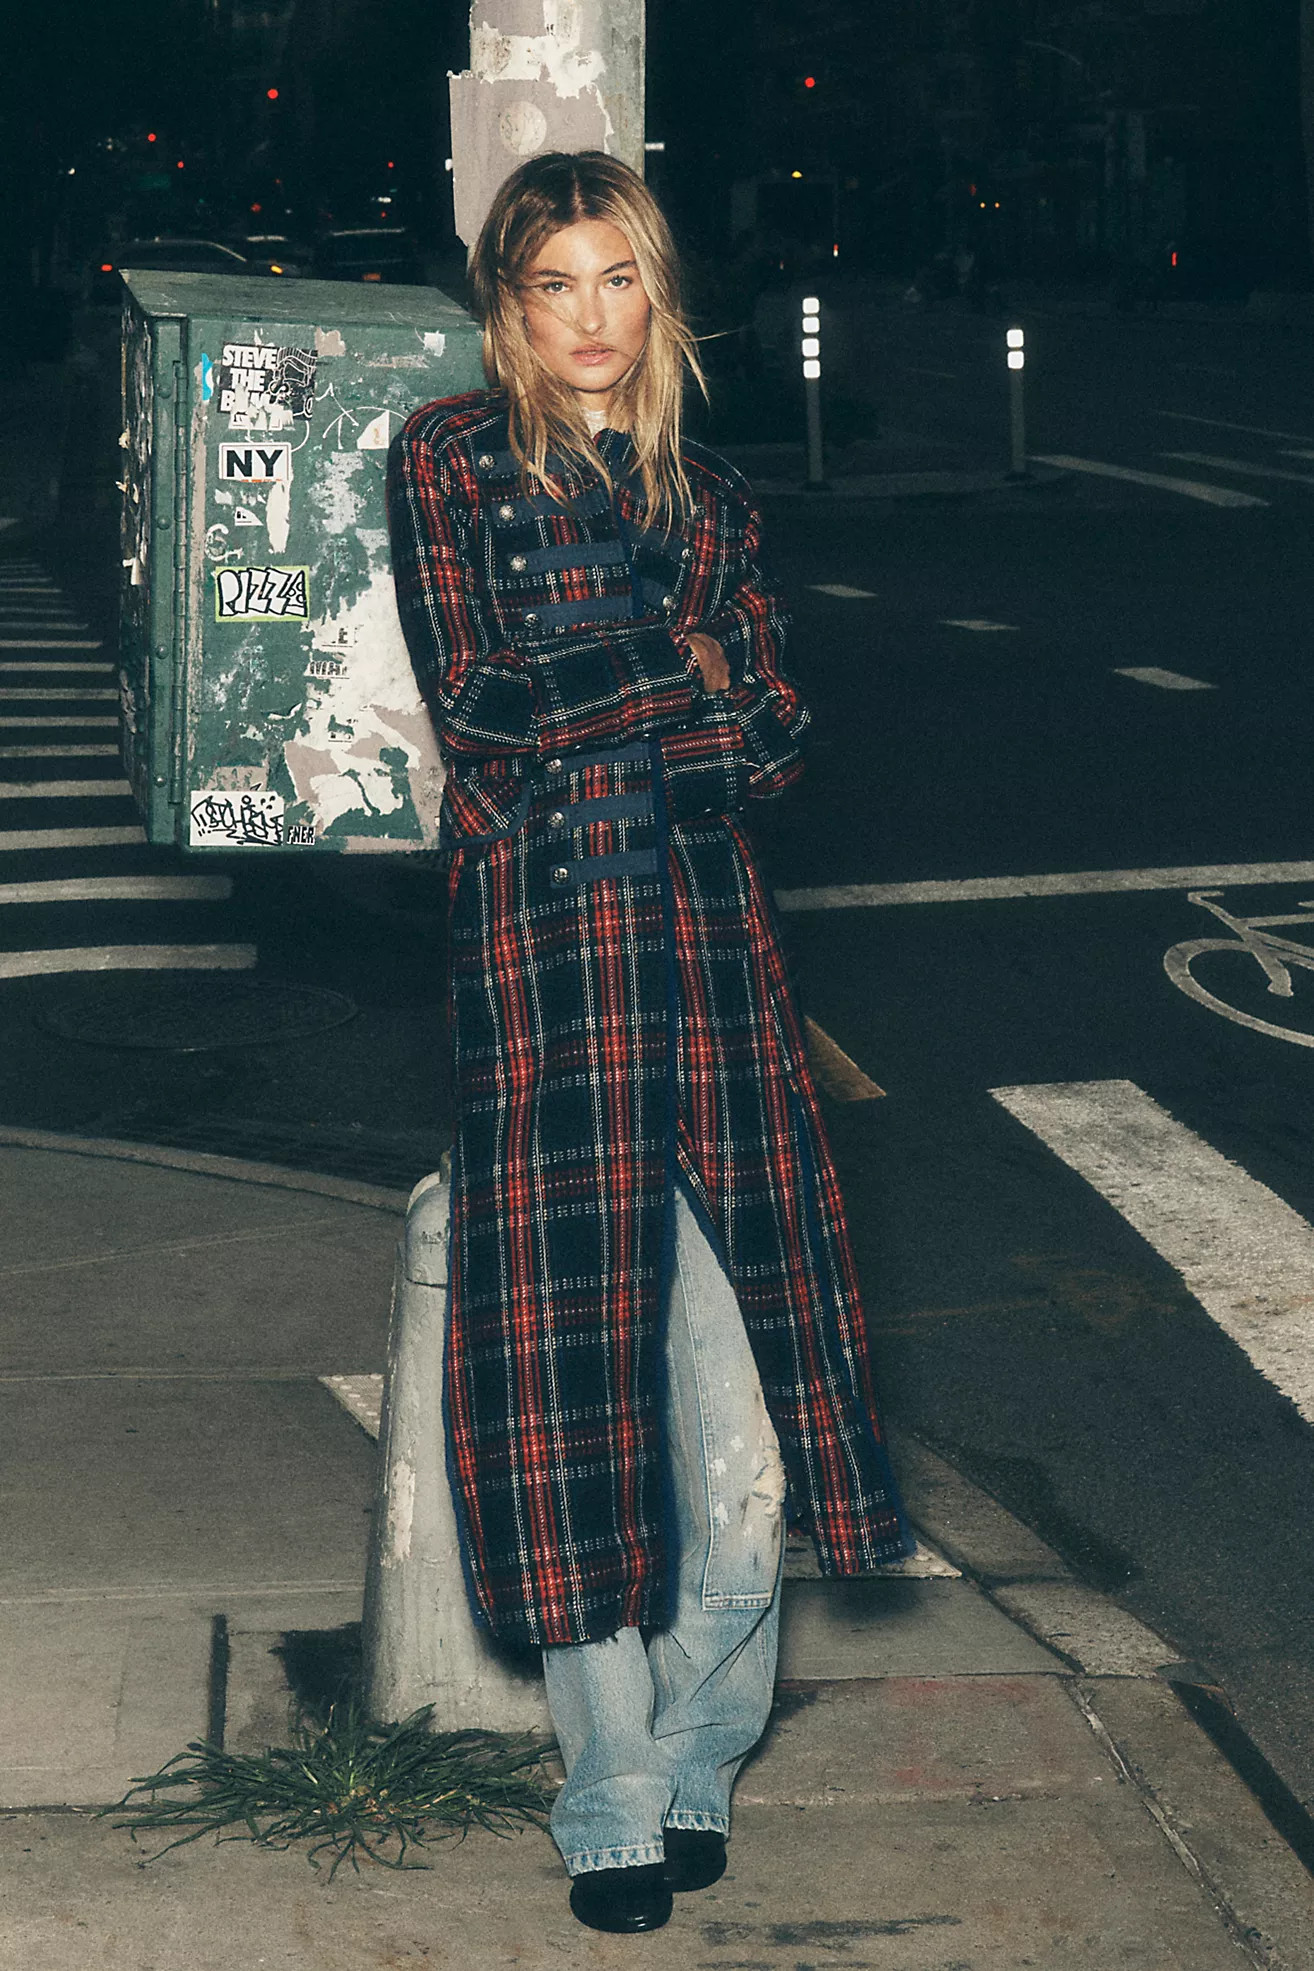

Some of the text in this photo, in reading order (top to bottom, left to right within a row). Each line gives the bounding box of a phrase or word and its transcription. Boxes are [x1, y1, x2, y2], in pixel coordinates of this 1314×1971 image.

[222, 344, 277, 371] STEVE
[230, 368, 266, 392] THE
[226, 449, 284, 478] NY
